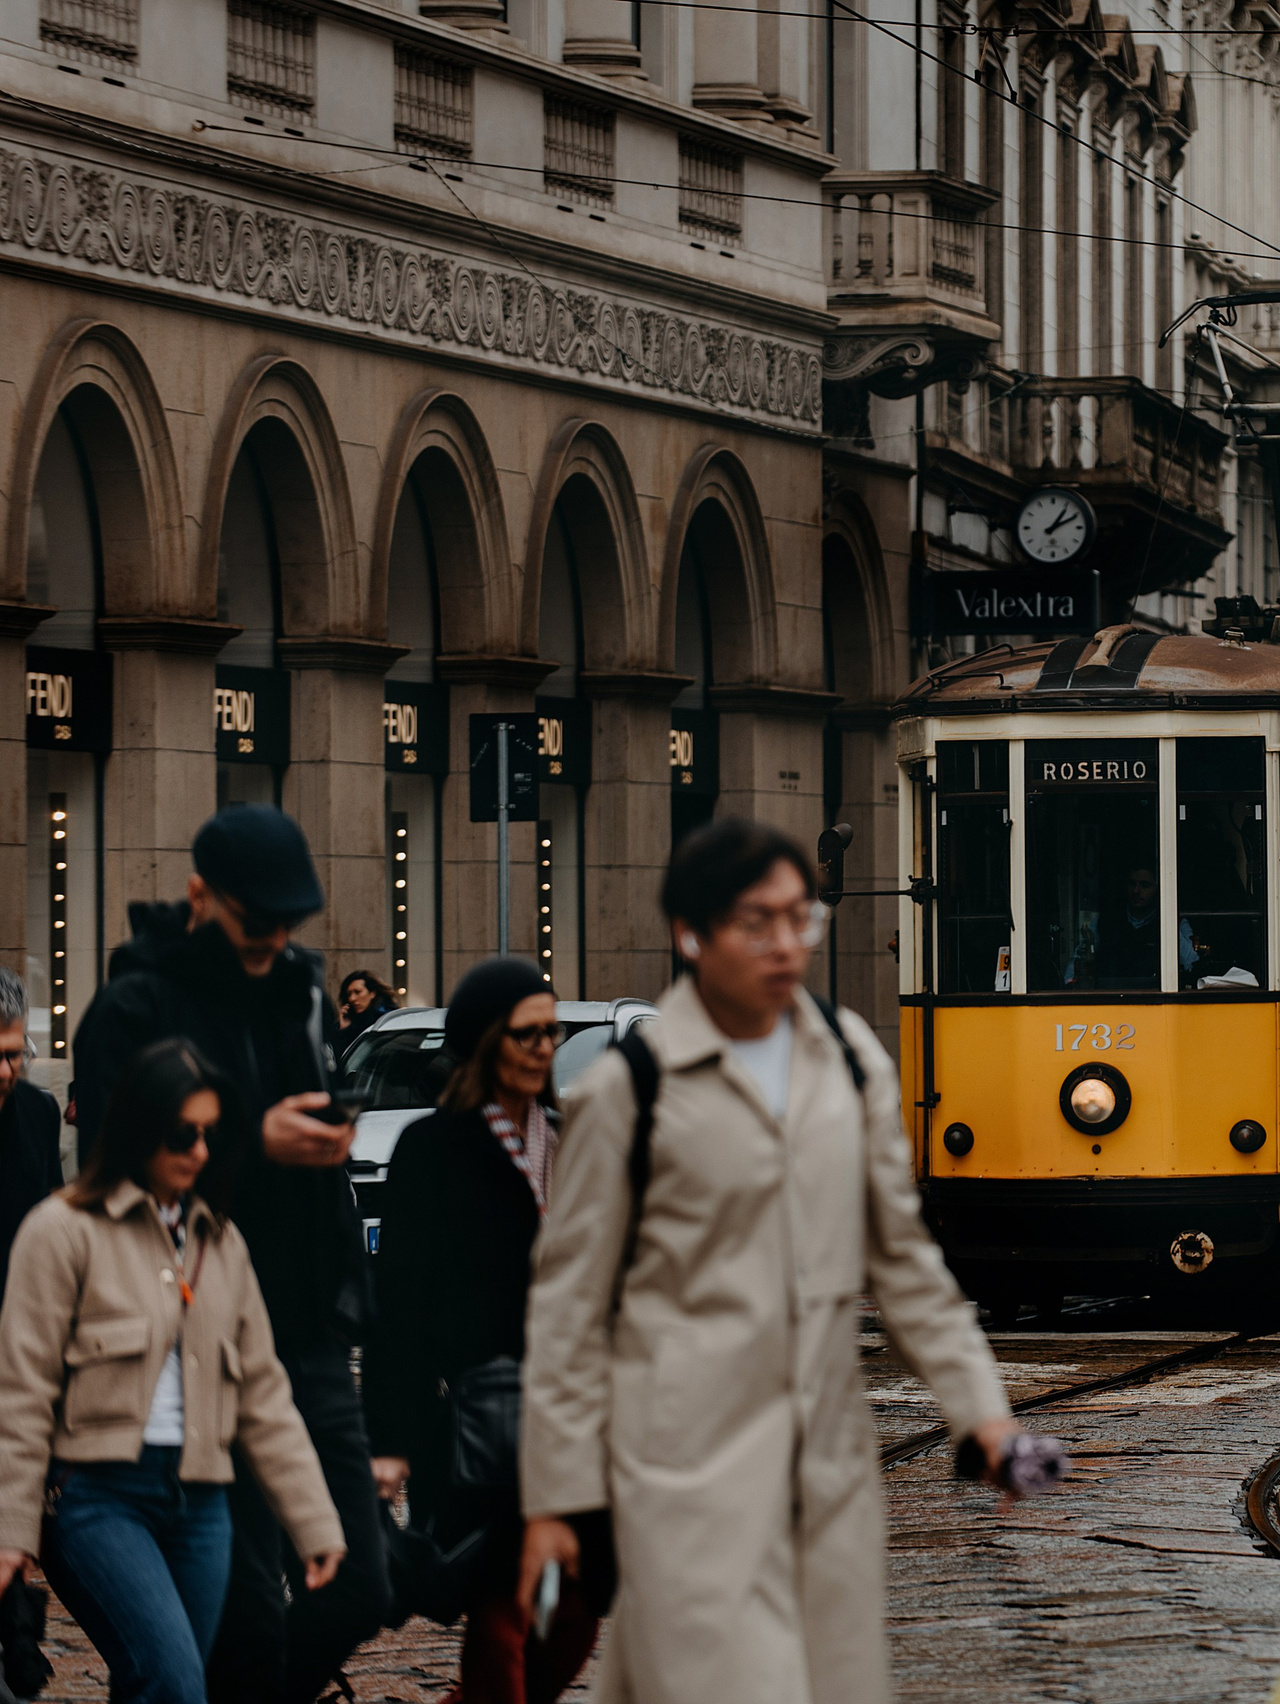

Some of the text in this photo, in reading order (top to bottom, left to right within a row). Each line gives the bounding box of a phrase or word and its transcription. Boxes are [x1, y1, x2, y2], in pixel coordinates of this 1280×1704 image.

[955, 588, 1074, 618] Valextra
[26, 672, 73, 718] FENDI
[213, 687, 255, 732] FENDI
[1043, 761, 1147, 780] ROSERIO
[1055, 1023, 1136, 1051] 1732
